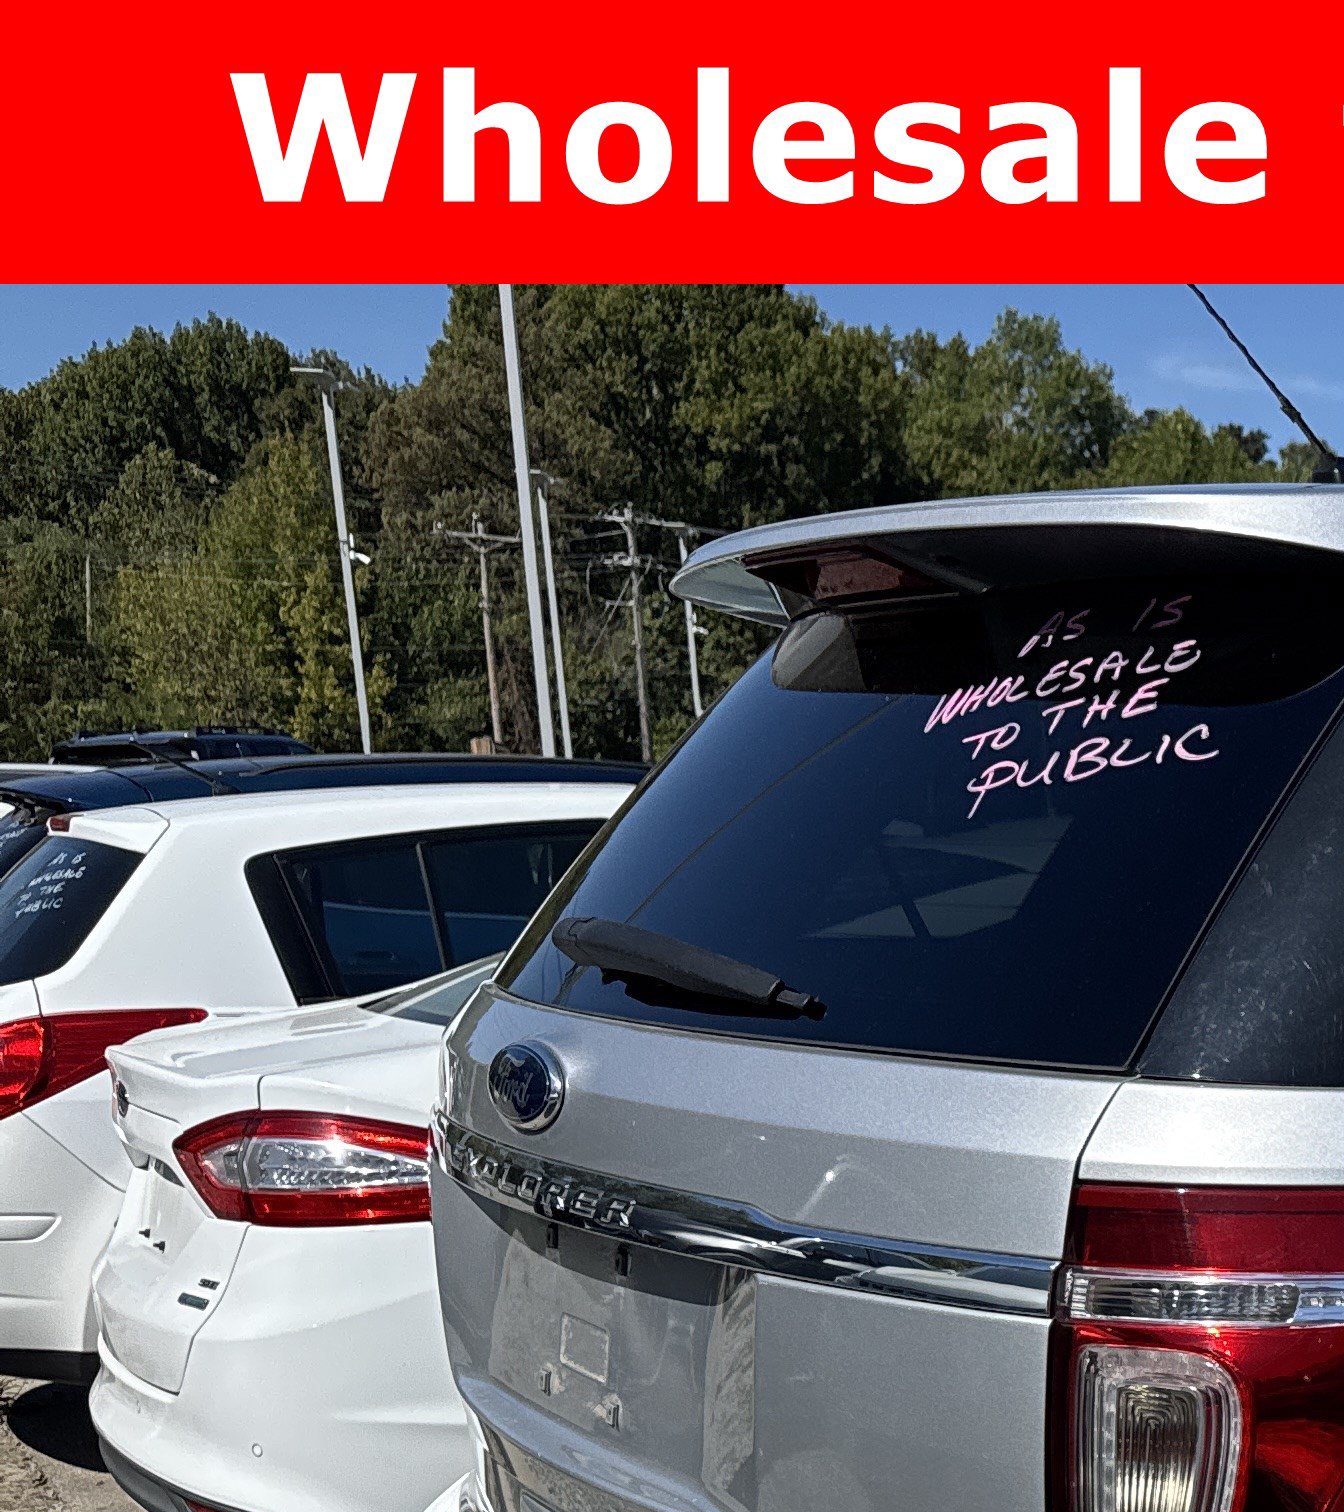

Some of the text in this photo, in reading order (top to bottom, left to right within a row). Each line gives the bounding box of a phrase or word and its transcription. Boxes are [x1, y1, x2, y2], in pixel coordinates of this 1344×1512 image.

[1017, 595, 1193, 659] AS IS
[923, 639, 1202, 734] WHOLESALE
[961, 677, 1171, 760] TO THE
[966, 723, 1220, 820] PUBLIC
[494, 1054, 534, 1109] Ford
[449, 1145, 637, 1228] EXPLORER
